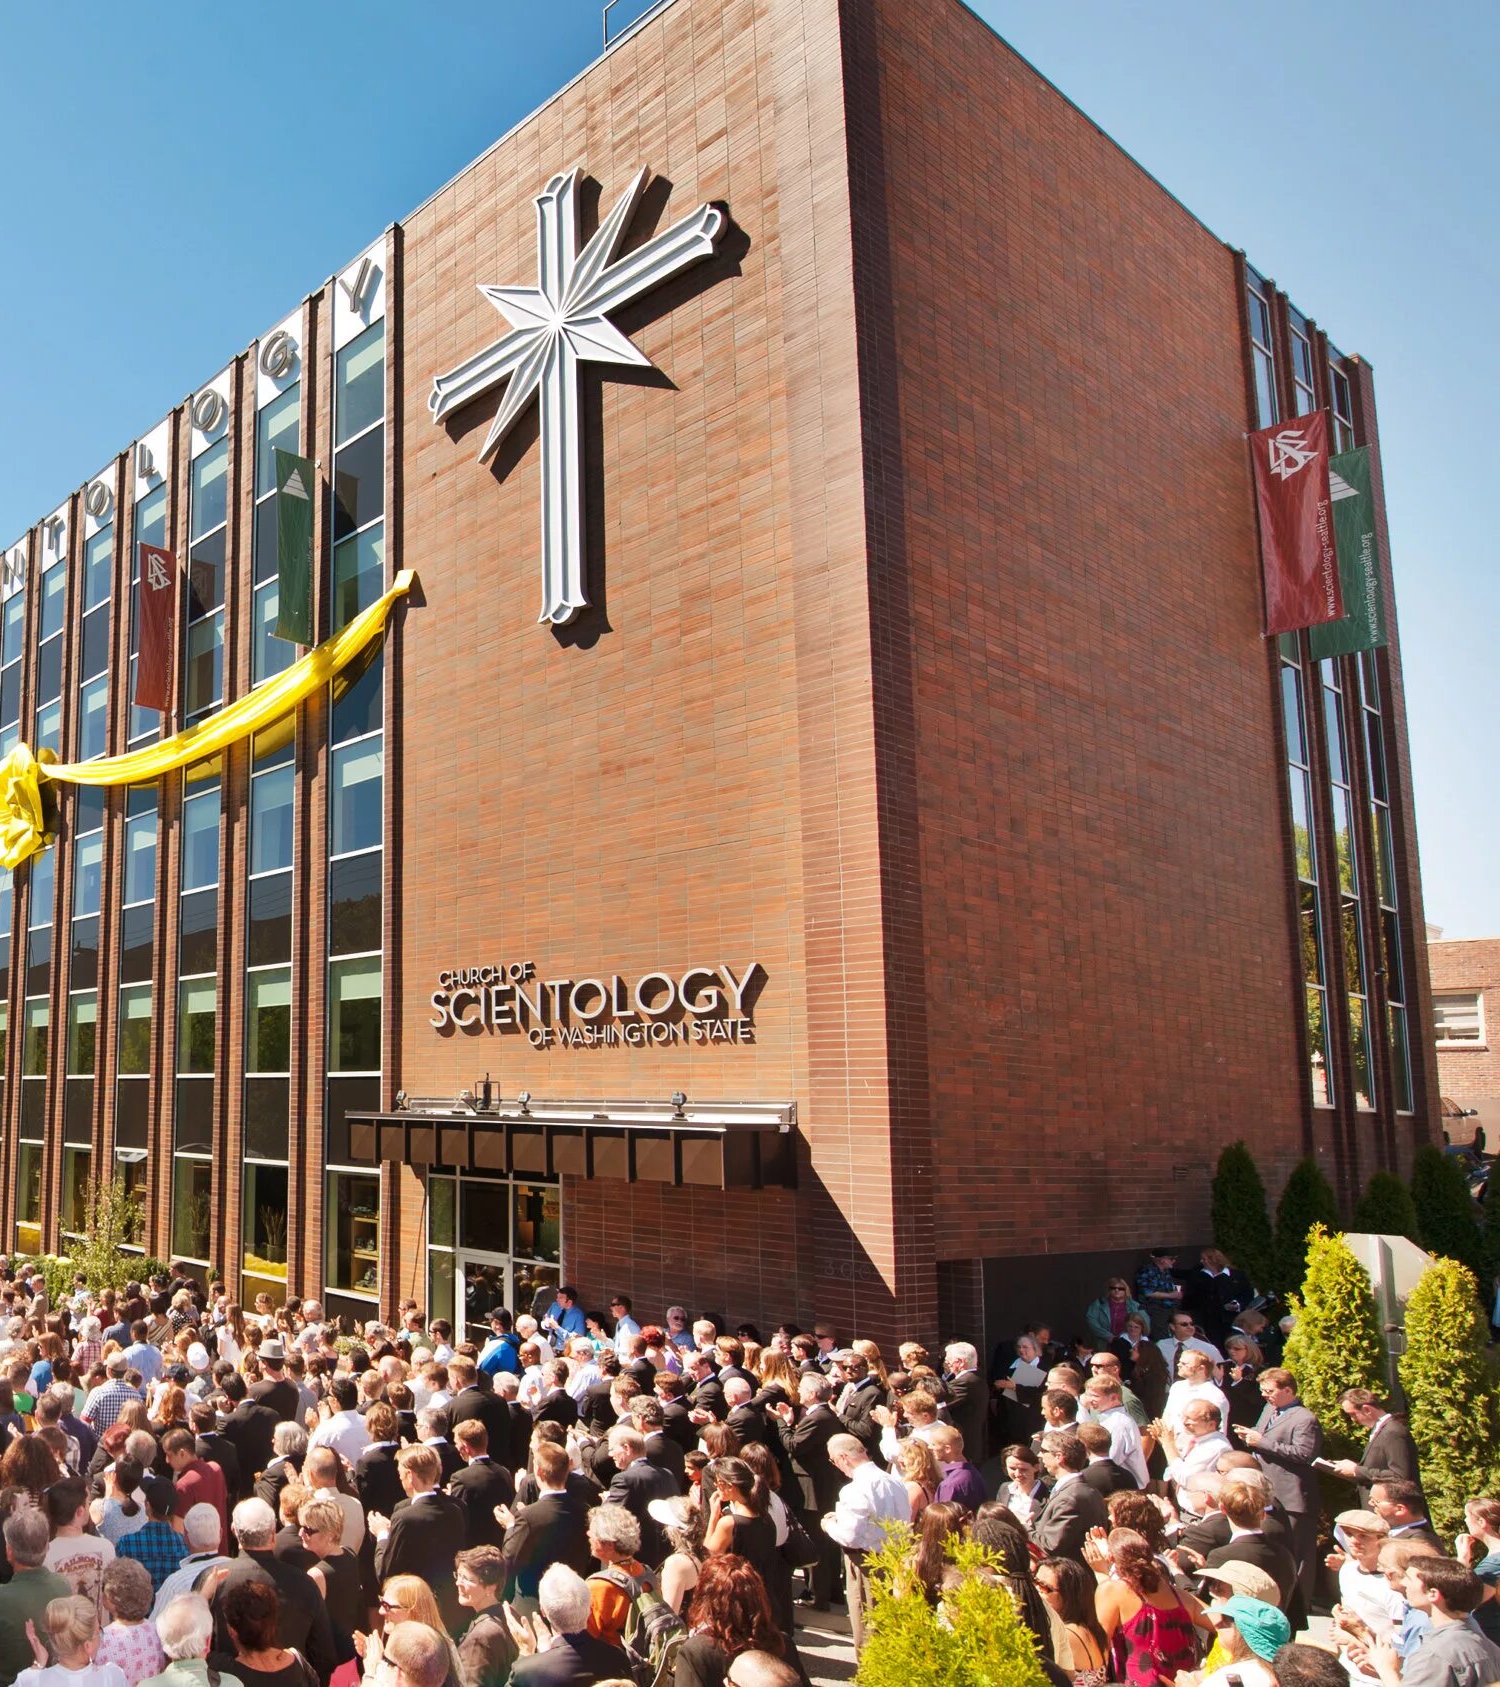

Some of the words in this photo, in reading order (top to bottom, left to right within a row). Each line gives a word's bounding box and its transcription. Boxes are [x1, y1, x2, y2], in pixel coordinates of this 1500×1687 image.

[1315, 499, 1337, 617] www.scientology-seattle.org
[1360, 532, 1378, 643] www.scientology-seattle.org
[429, 962, 757, 1028] SCIENTOLOGY
[438, 964, 501, 988] CHURCH
[509, 961, 534, 980] OF
[528, 1027, 552, 1046] OF
[557, 1021, 685, 1045] WASHINGTON
[690, 1018, 750, 1040] STATE
